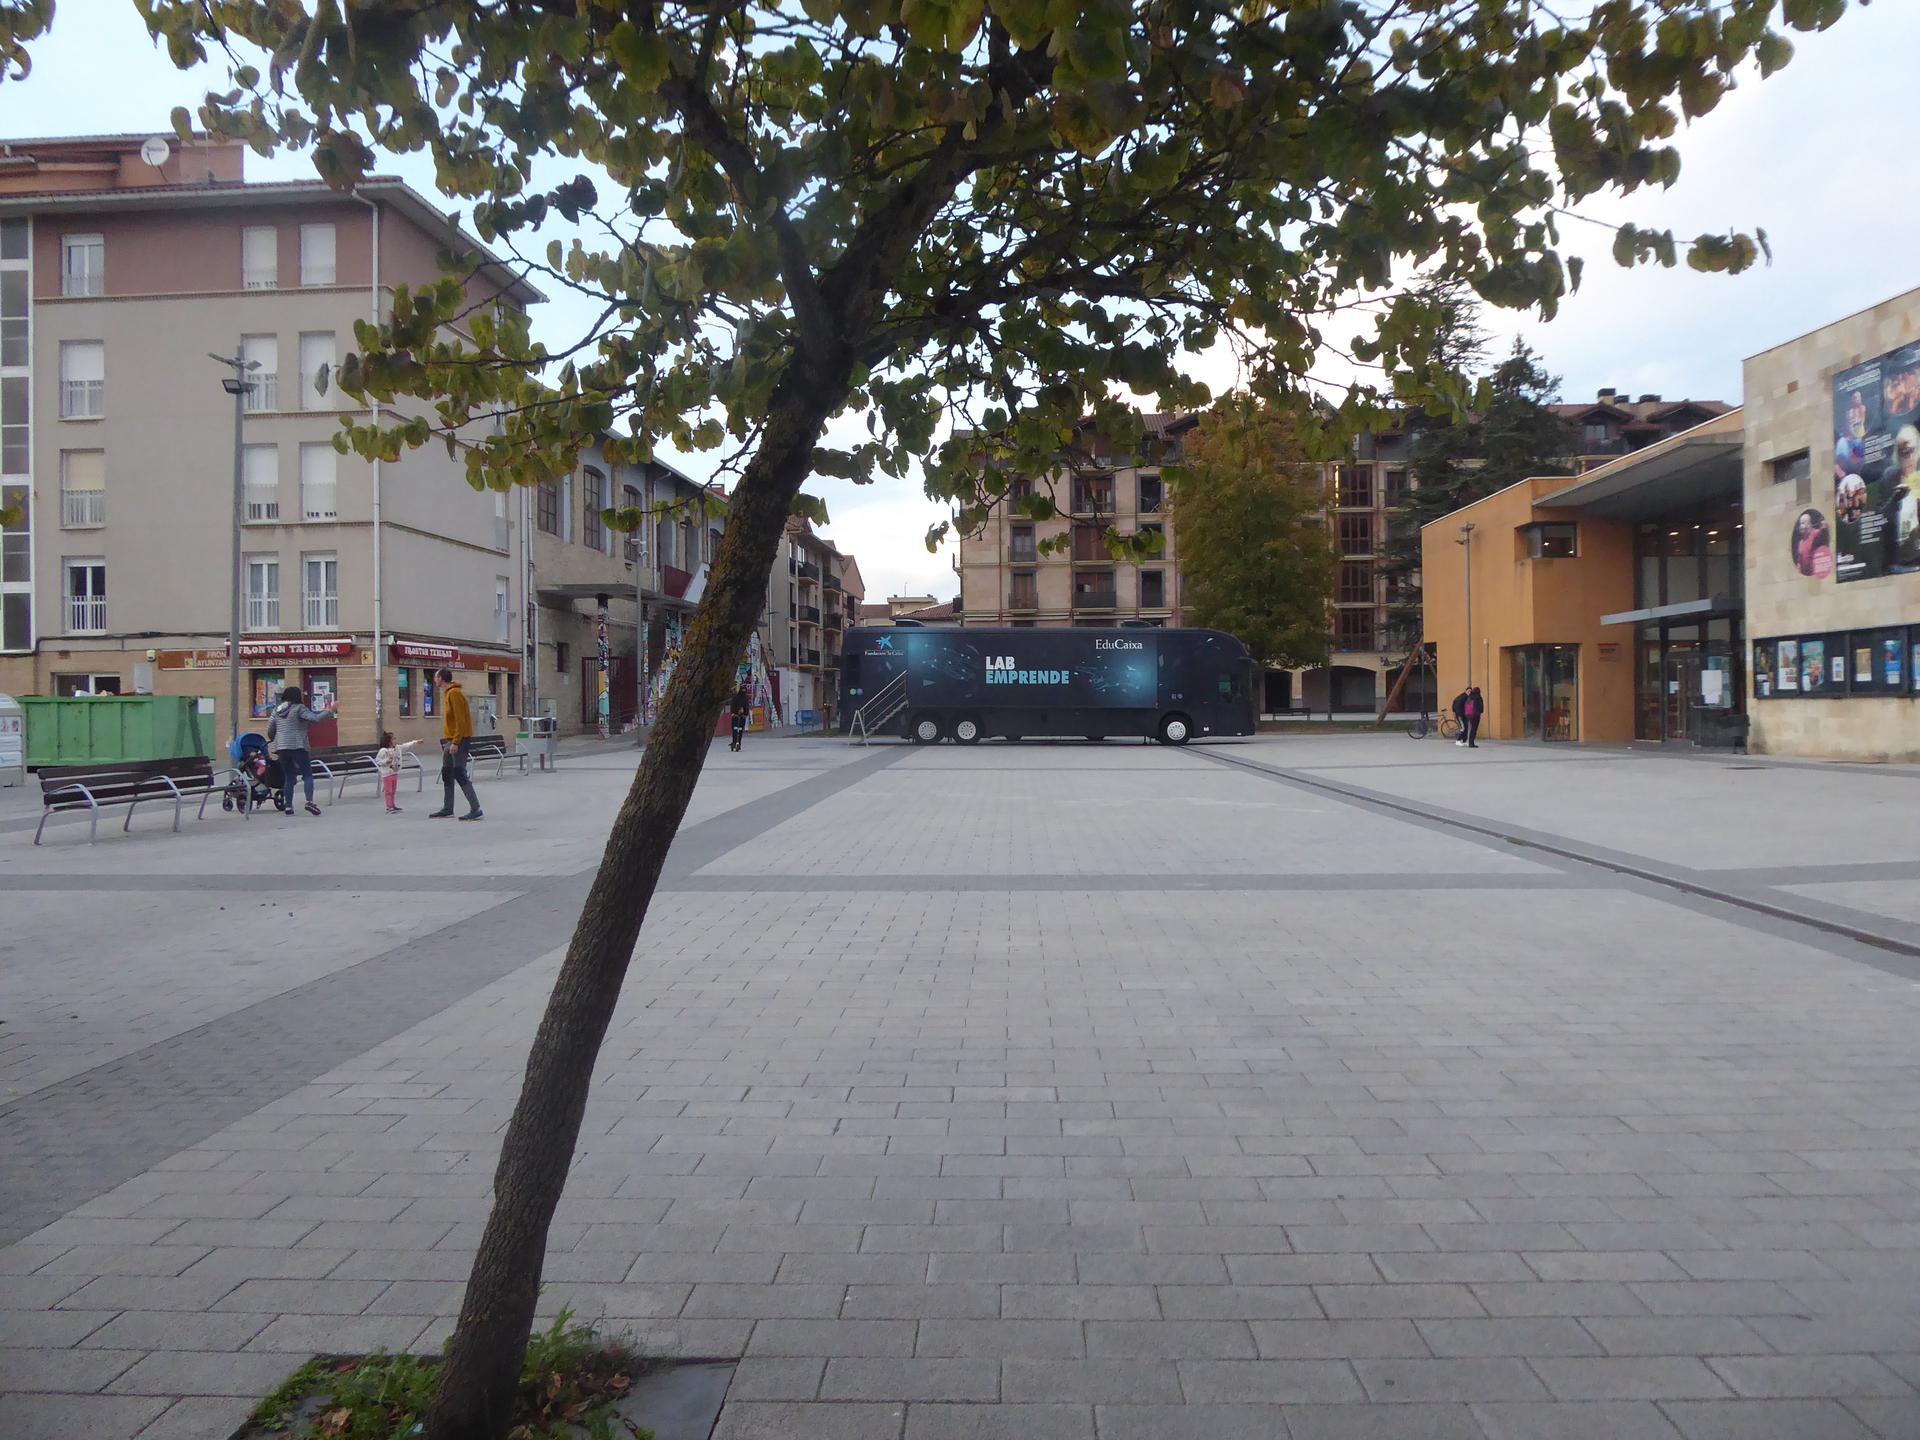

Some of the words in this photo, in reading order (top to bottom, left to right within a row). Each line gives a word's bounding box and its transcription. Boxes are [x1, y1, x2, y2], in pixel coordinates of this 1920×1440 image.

[239, 645, 286, 654] FRONTON
[289, 644, 338, 653] TABERNA
[1095, 639, 1143, 650] EduCaixa
[315, 657, 340, 665] UDALA
[985, 656, 1015, 670] LAB
[985, 670, 1070, 684] EMPRENDE
